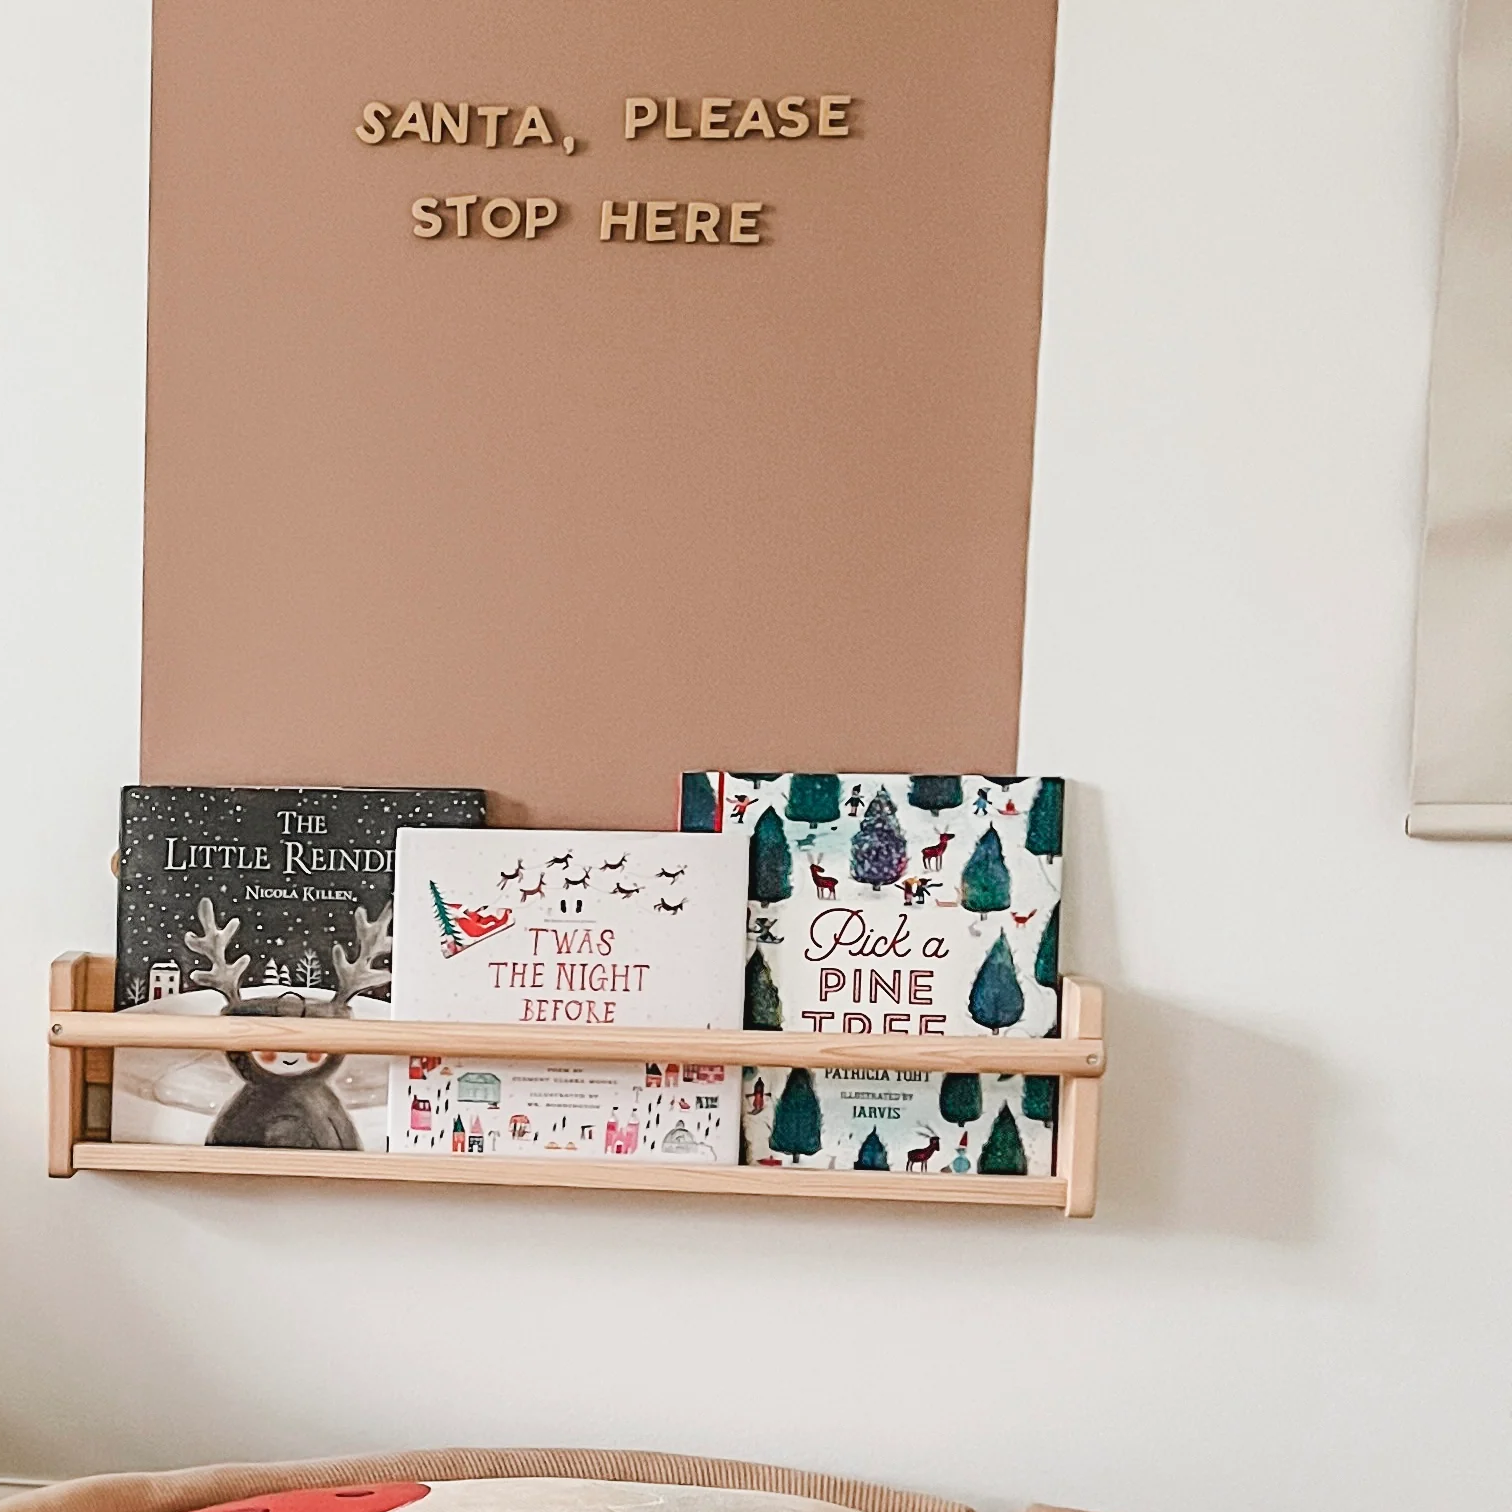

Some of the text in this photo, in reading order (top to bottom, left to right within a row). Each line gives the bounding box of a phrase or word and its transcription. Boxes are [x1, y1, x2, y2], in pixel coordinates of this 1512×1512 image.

[355, 94, 852, 155] SANTA, PLEASE
[412, 195, 764, 243] STOP HERE
[277, 811, 328, 834] THE
[164, 837, 271, 871] LITTLE
[245, 885, 353, 902] NICOLA KILLEN
[804, 908, 950, 961] Pick a
[488, 962, 650, 992] THE NIGHT
[819, 967, 934, 1005] PINE
[519, 999, 616, 1024] BEFORE
[824, 1068, 890, 1081] PATRICIA
[853, 1105, 901, 1119] JARVIS
